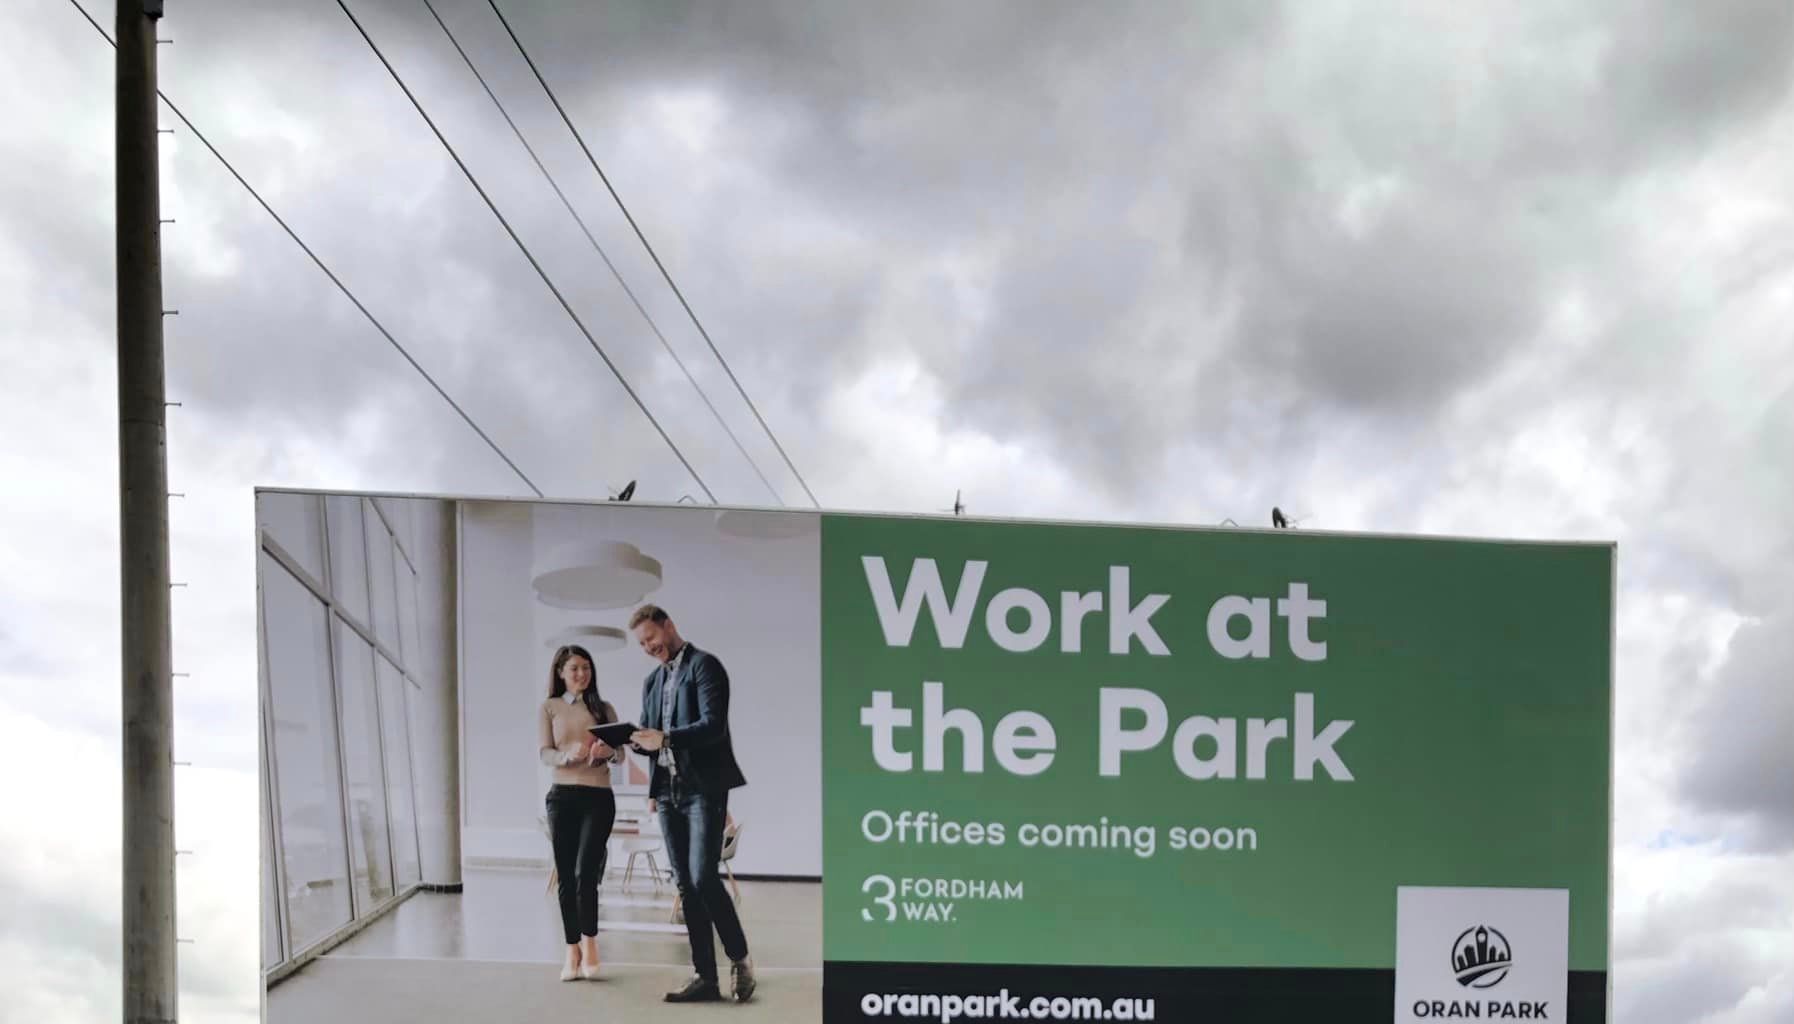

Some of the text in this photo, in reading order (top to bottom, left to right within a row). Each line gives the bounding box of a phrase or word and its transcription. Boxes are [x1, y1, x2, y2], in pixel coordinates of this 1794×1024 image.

[861, 555, 1328, 662] Work at
[860, 681, 1355, 781] the Park
[861, 810, 1258, 858] Offices coming soon
[861, 874, 898, 922] 3
[900, 877, 1024, 900] FORDHAM
[902, 902, 957, 922] WAY.
[860, 988, 1155, 1024] oranpark.com.au
[1412, 1000, 1549, 1020] ORAN PARK
